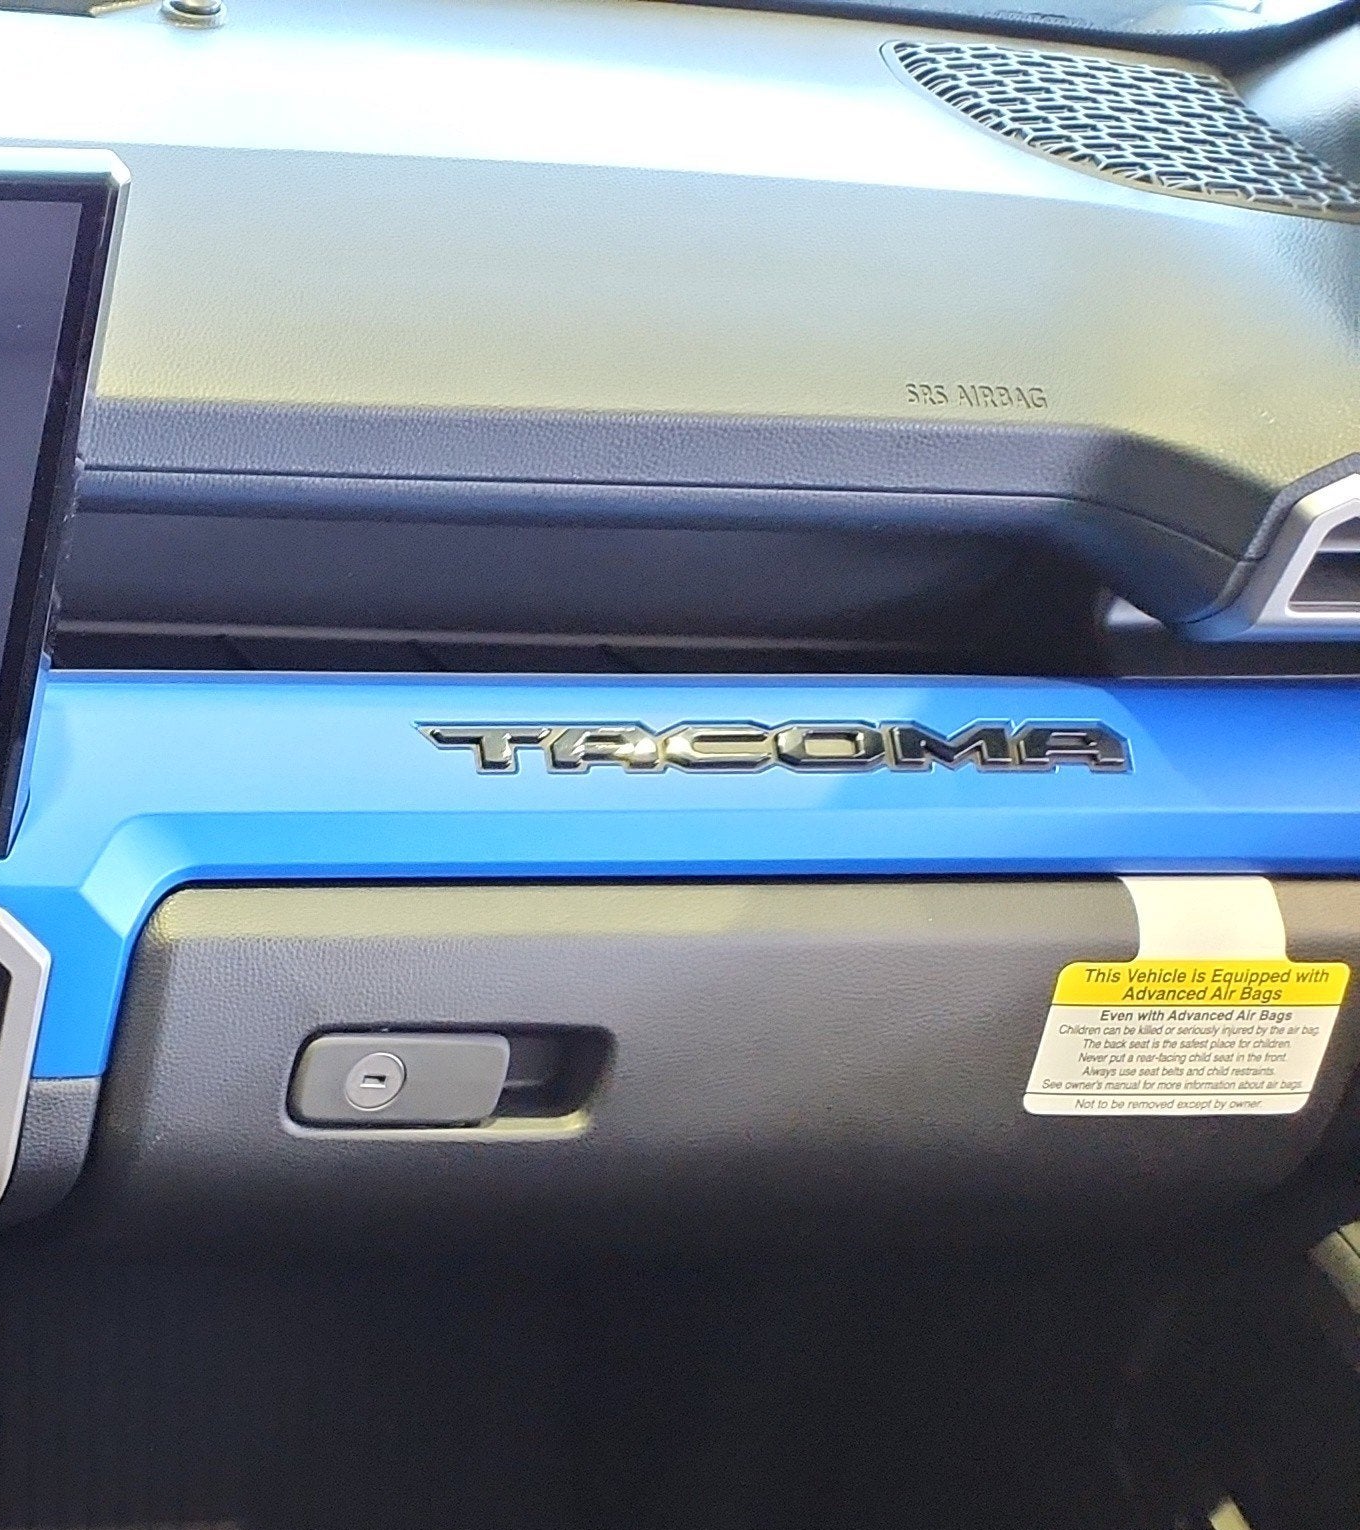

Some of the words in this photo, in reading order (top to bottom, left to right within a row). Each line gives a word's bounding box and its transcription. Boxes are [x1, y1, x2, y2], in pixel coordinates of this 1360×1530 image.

[905, 382, 949, 405] SRS
[957, 383, 1049, 409] AIRBAG
[411, 719, 1135, 776] TACOMA
[1085, 968, 1122, 983] This
[1127, 968, 1187, 983] Vehicle
[1211, 968, 1292, 986] Equipped
[1295, 968, 1330, 983] with
[1121, 986, 1209, 1001] Advanced
[1210, 986, 1237, 1001] Air
[1239, 986, 1283, 1004] Bags
[1099, 1009, 1134, 1021] Even
[1137, 1009, 1165, 1021] with
[1166, 1009, 1235, 1021] Advanced
[1235, 1009, 1258, 1021] Air
[1259, 1010, 1294, 1024] Bags
[1059, 1024, 1101, 1035] Children
[1103, 1026, 1122, 1035] can
[1123, 1025, 1136, 1035] be
[1137, 1025, 1164, 1035] killed
[1164, 1027, 1176, 1035] or
[1176, 1025, 1220, 1037] seriously
[1222, 1025, 1254, 1036] injured
[1255, 1025, 1269, 1036] by
[1269, 1026, 1285, 1035] the
[1286, 1026, 1300, 1035] air
[1083, 1038, 1102, 1048] The
[1103, 1039, 1127, 1049] back
[1129, 1039, 1151, 1049] seat
[1162, 1039, 1178, 1048] the
[1179, 1039, 1209, 1049] safest
[1209, 1039, 1236, 1050] place
[1238, 1039, 1252, 1049] for
[1078, 1053, 1108, 1063] Never
[1108, 1053, 1126, 1064] put
[1136, 1053, 1186, 1065] rear-facing
[1189, 1053, 1211, 1062] child
[1213, 1053, 1234, 1062] seat
[1247, 1053, 1262, 1062] the
[1082, 1066, 1117, 1078] Always
[1119, 1068, 1137, 1077] use
[1138, 1067, 1160, 1077] seat
[1161, 1066, 1185, 1076] belts
[1186, 1066, 1205, 1076] and
[1206, 1066, 1230, 1076] child
[1042, 1079, 1063, 1089] See
[1104, 1080, 1140, 1089] manual
[1142, 1080, 1155, 1089] for
[1157, 1081, 1182, 1089] more
[1184, 1080, 1236, 1089] information
[1237, 1080, 1265, 1089] about
[1266, 1080, 1279, 1089] air
[1074, 1099, 1094, 1109] Not
[1098, 1100, 1109, 1109] to
[1110, 1099, 1125, 1109] be
[1127, 1099, 1175, 1109] removed
[1176, 1099, 1212, 1110] except
[1214, 1100, 1226, 1111] by
